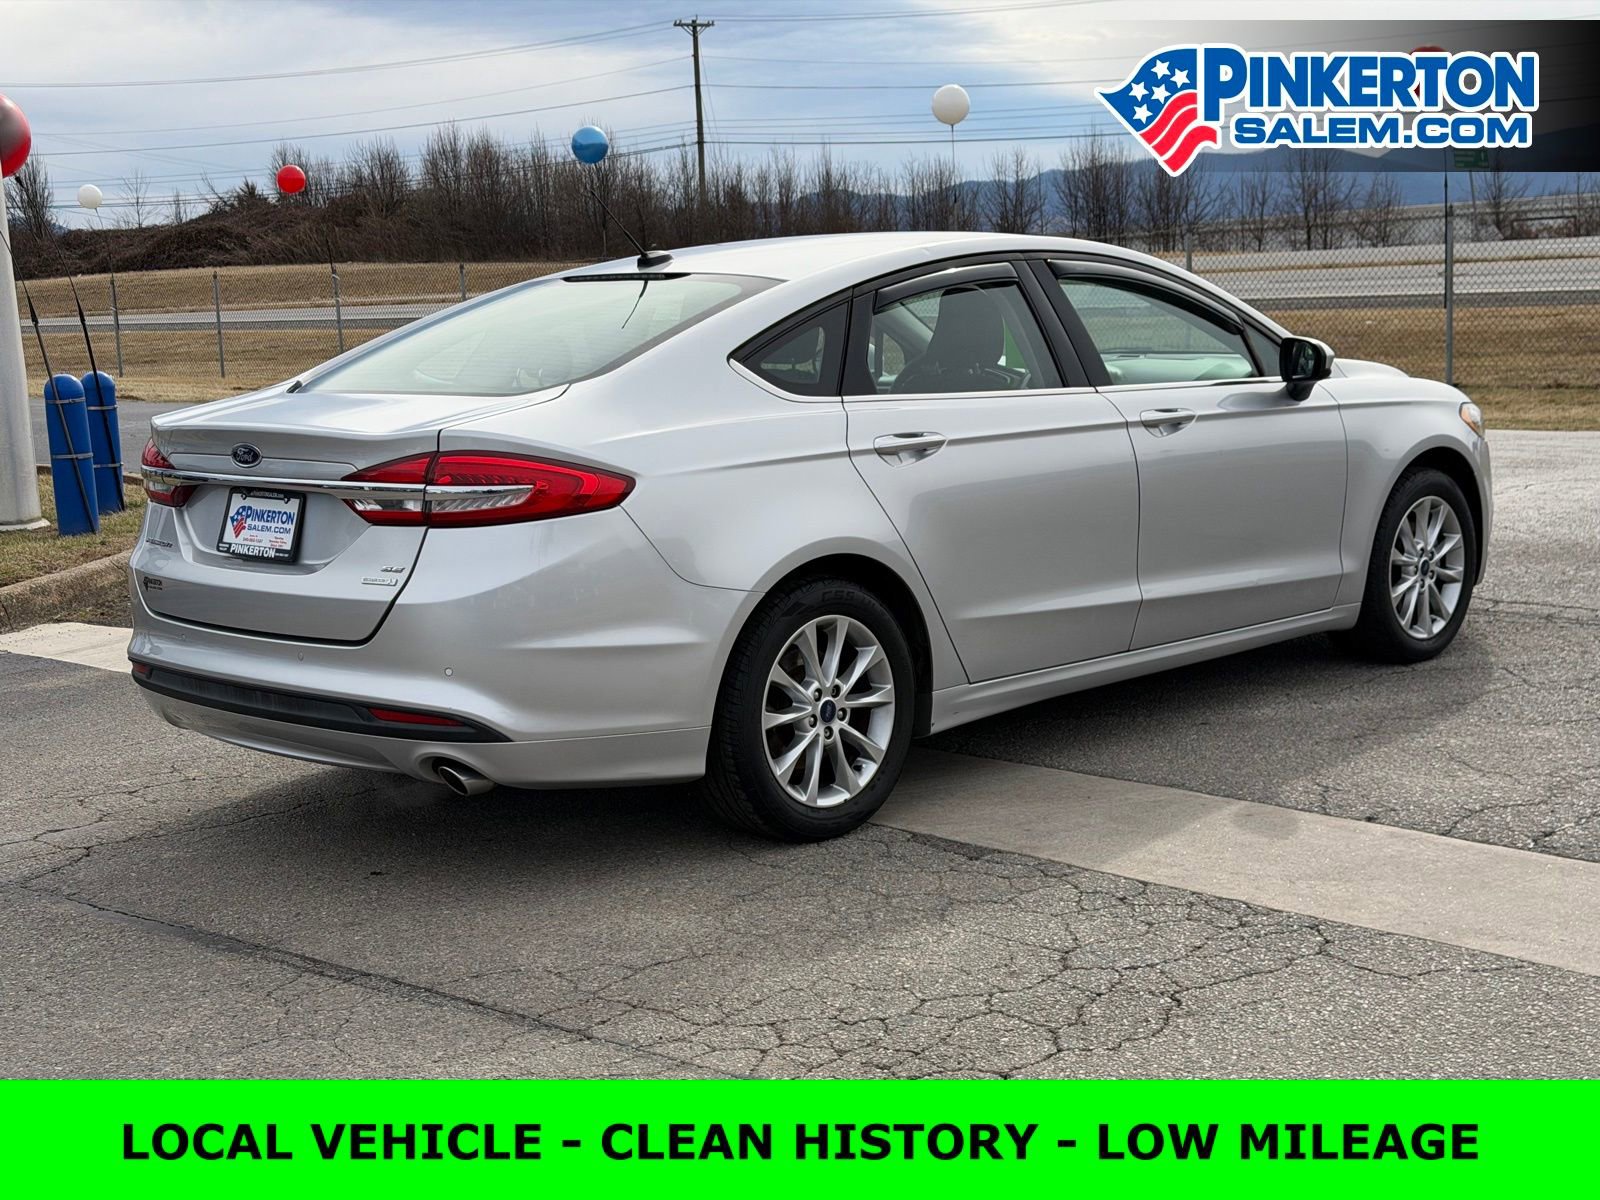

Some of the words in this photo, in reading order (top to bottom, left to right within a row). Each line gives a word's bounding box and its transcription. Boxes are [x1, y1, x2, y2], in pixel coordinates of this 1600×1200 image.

[244, 506, 295, 525] PINKERTON
[247, 523, 291, 535] SALEM.COM
[230, 544, 276, 558] PINKERTON
